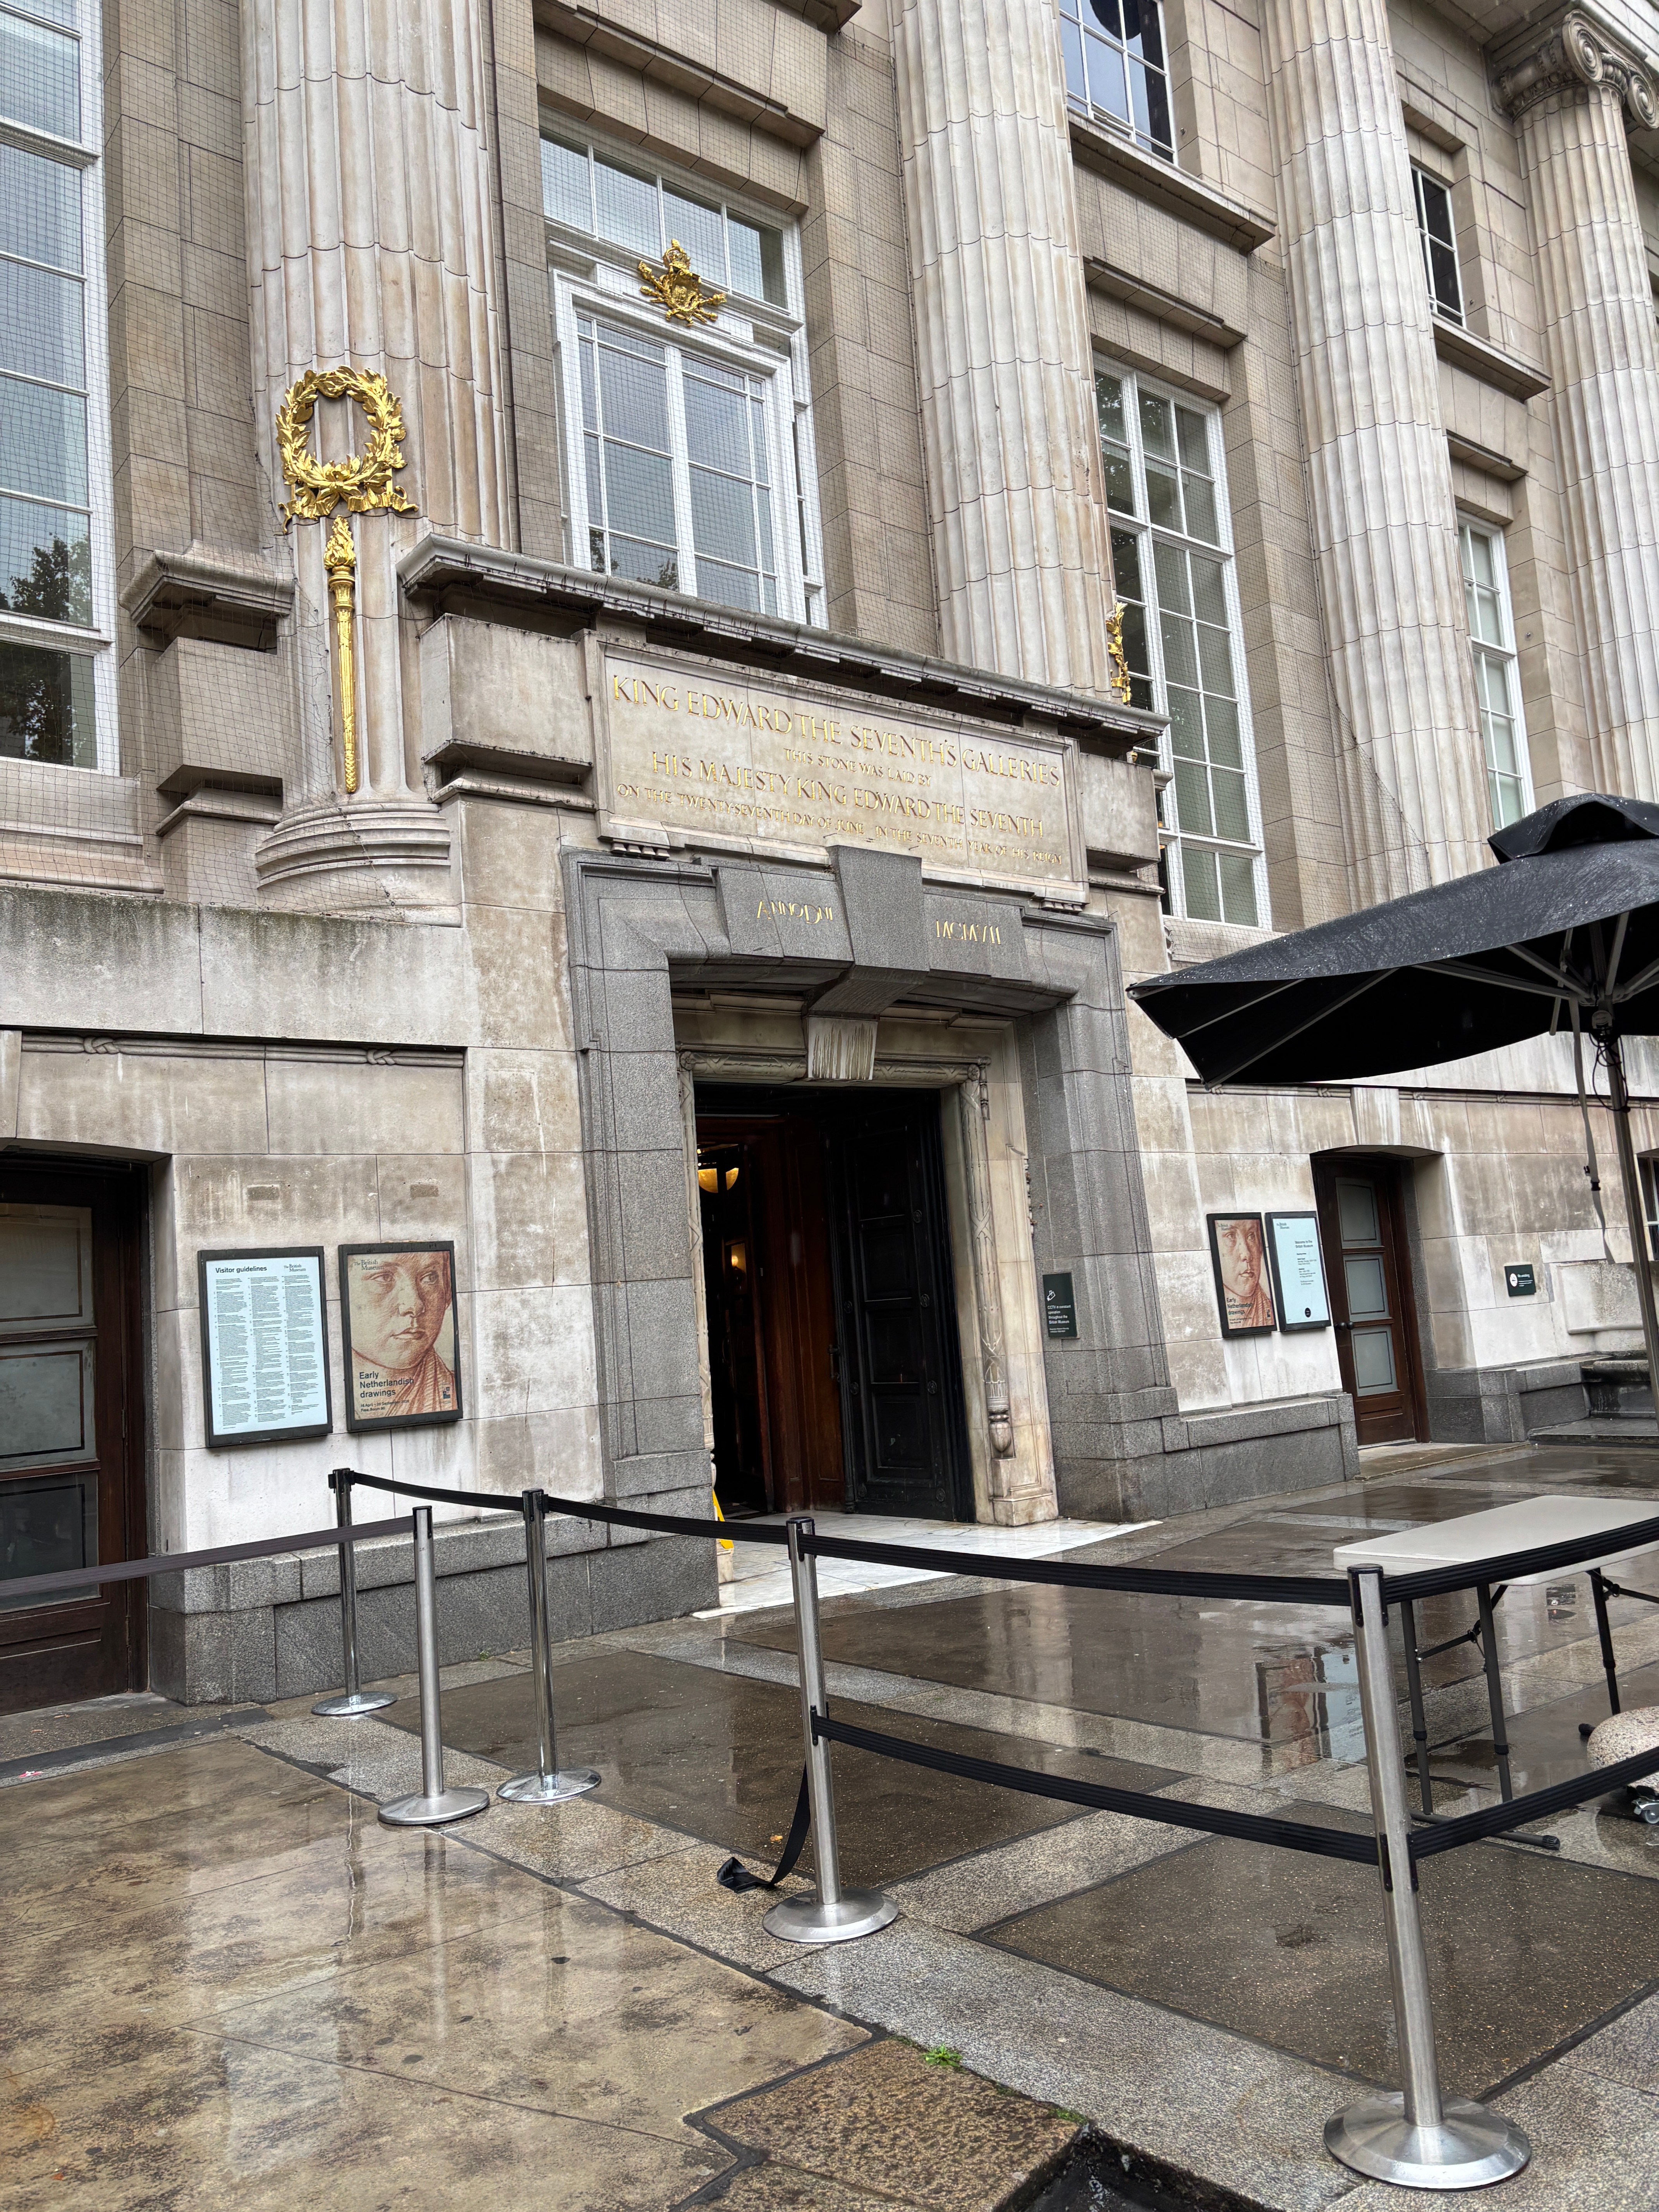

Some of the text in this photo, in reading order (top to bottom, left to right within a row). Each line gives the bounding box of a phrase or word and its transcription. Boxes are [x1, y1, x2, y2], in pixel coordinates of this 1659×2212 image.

[614, 675, 678, 711] KING
[687, 690, 792, 734] EDWARD
[795, 713, 842, 745] THE
[962, 749, 1060, 787] GALLERIES
[783, 748, 931, 787] THIS STONE WAS LAID BY
[653, 751, 1043, 838] HIS MAJESTY KING EDWARD THE SEVENTH
[617, 784, 1061, 865] ON THE TWENTY-SEVENTH DAY OF JUNE IN THE SEVENTH YEAR OF HIS REIGN
[756, 900, 804, 920] ANNO
[359, 1371, 379, 1379] Early
[360, 1377, 414, 1389] Netherlandish
[360, 1389, 396, 1398] drawings
